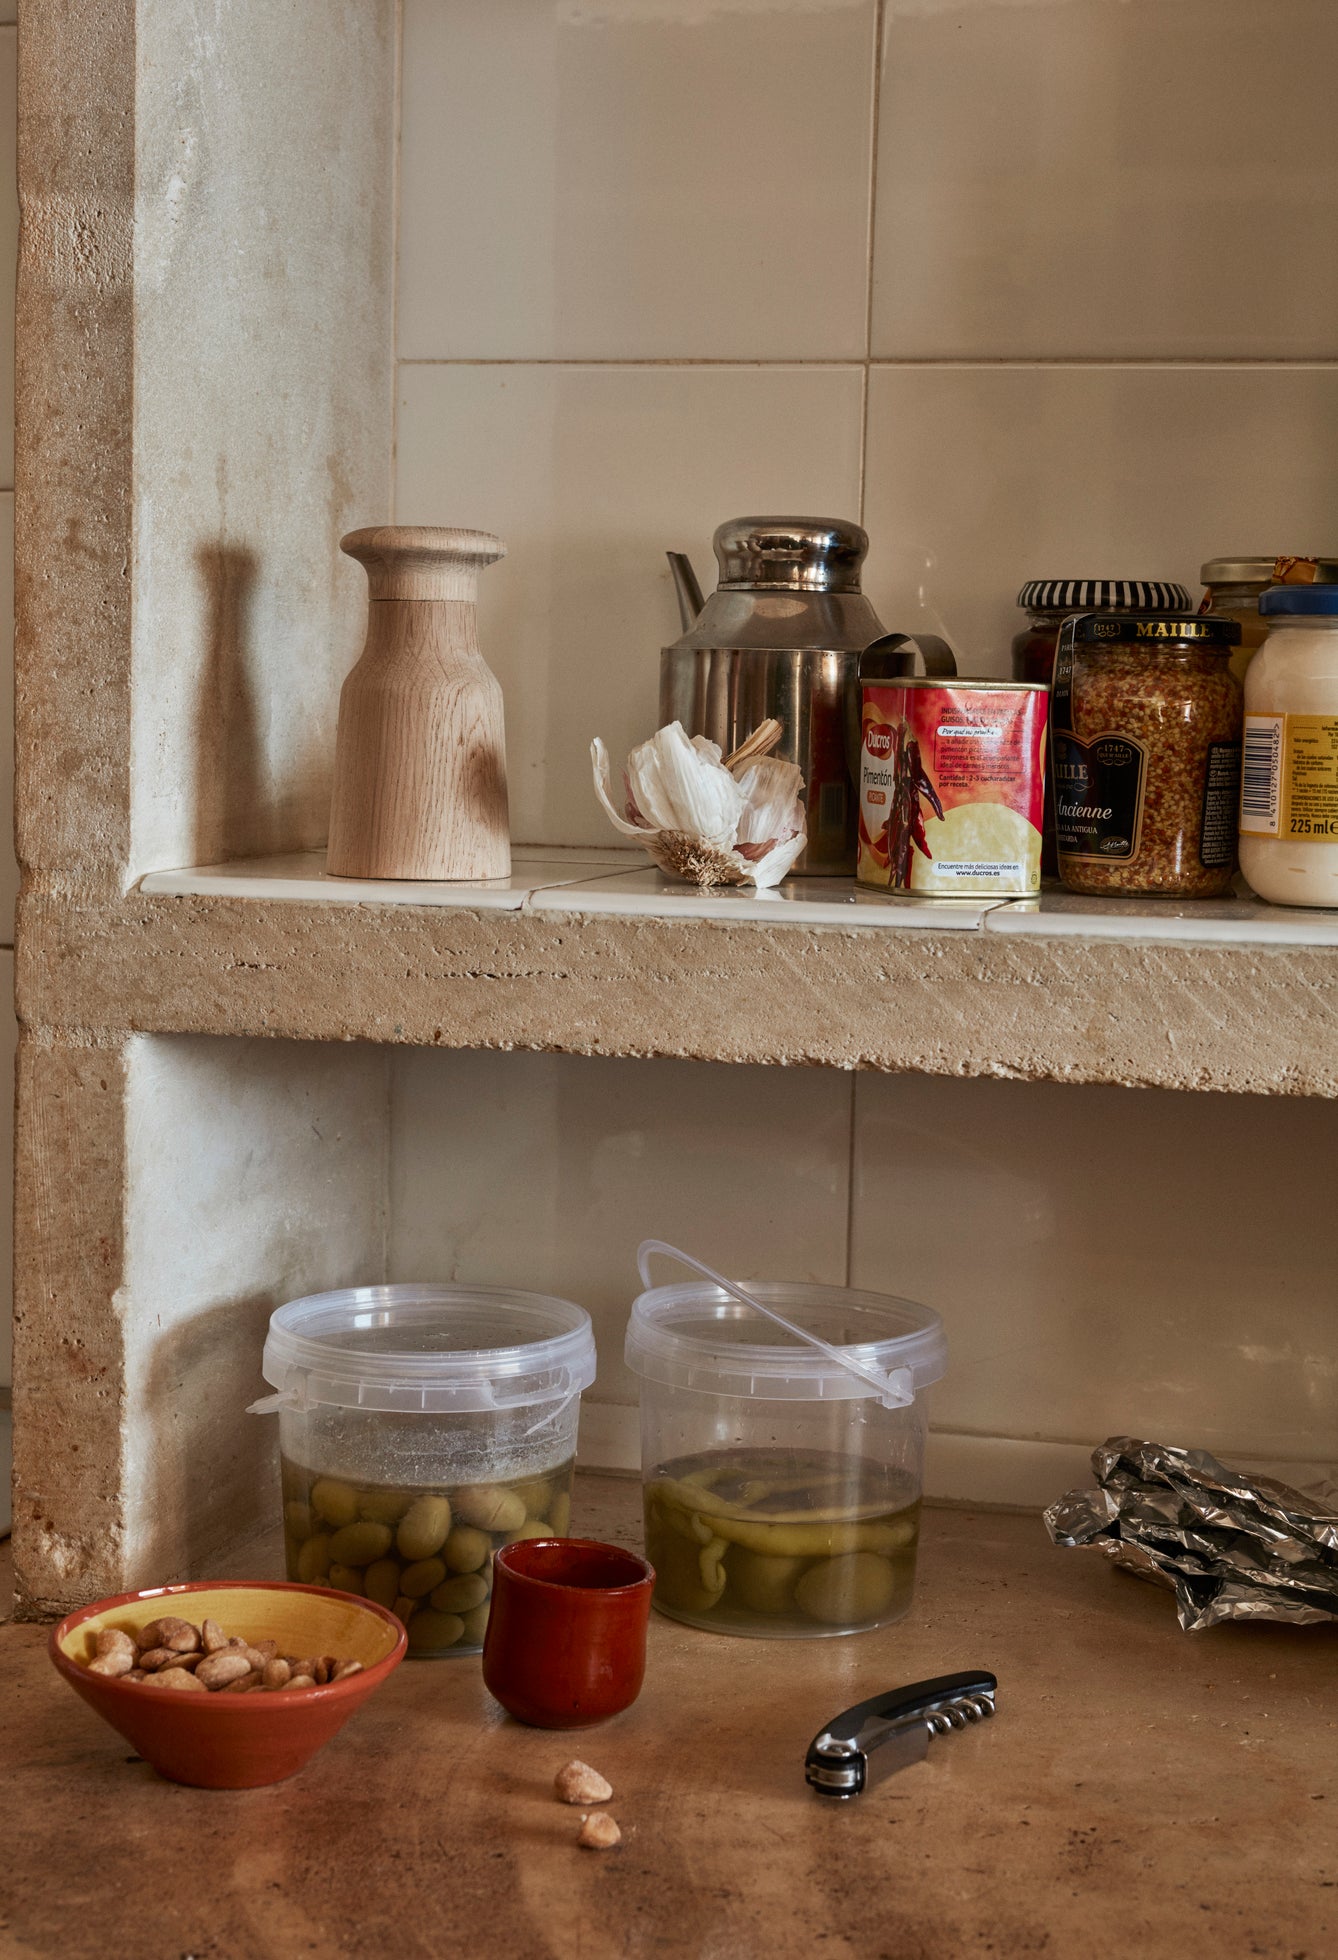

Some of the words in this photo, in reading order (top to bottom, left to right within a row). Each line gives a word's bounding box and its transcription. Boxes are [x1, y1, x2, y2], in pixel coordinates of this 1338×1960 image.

[1136, 622, 1211, 638] MAILLE
[867, 730, 890, 749] Ducros
[1104, 744, 1124, 753] 1747
[863, 766, 892, 787] Pimentón
[1072, 825, 1098, 834] ANTIGUA
[1290, 819, 1312, 833] 225
[1313, 819, 1329, 834] ml
[956, 869, 1001, 877] www.ducros.es
[975, 863, 999, 871] deliciosas
